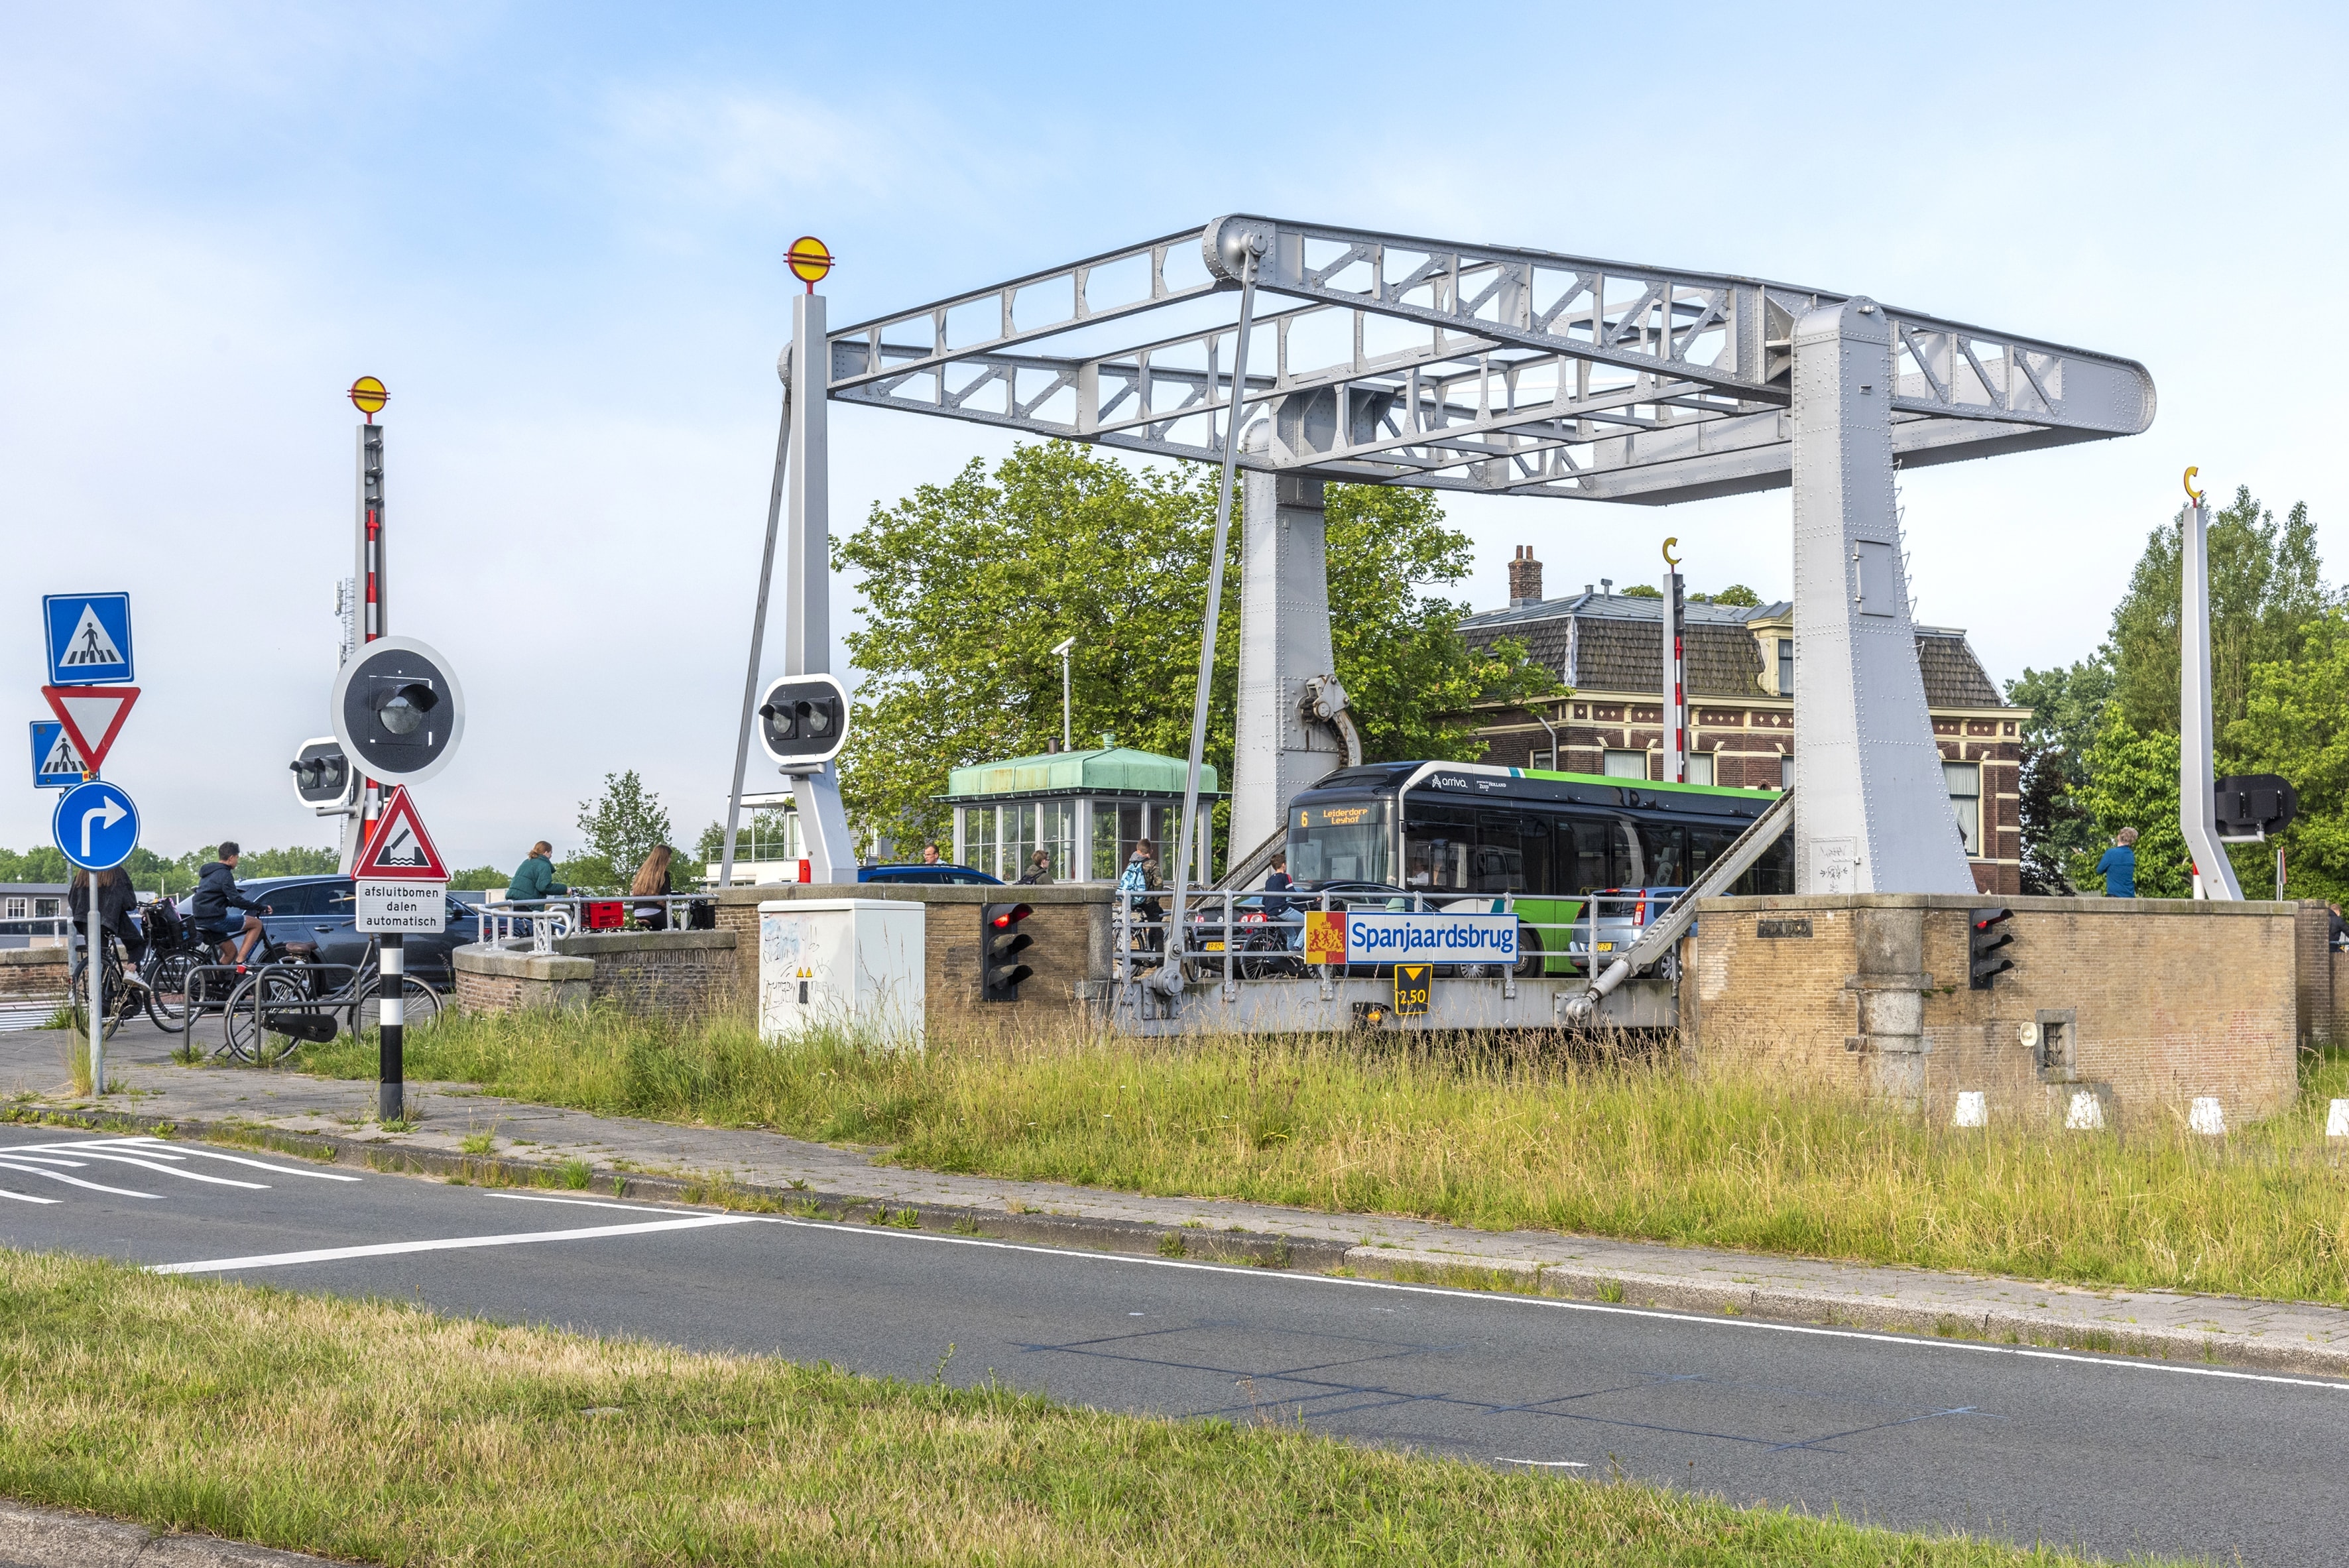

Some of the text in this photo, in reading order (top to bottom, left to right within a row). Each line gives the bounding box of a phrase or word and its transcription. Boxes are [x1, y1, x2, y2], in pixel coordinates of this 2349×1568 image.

[1442, 776, 1467, 788] arriva
[1301, 808, 1368, 827] 6 Leiderdorp
[1331, 815, 1360, 825] Leyhof
[365, 886, 438, 898] afsluitbomen
[387, 901, 417, 912] dalen
[366, 916, 436, 926] automatisch
[1352, 922, 1514, 953] Spanjaardsbrug
[1400, 989, 1426, 1006] 2,50
